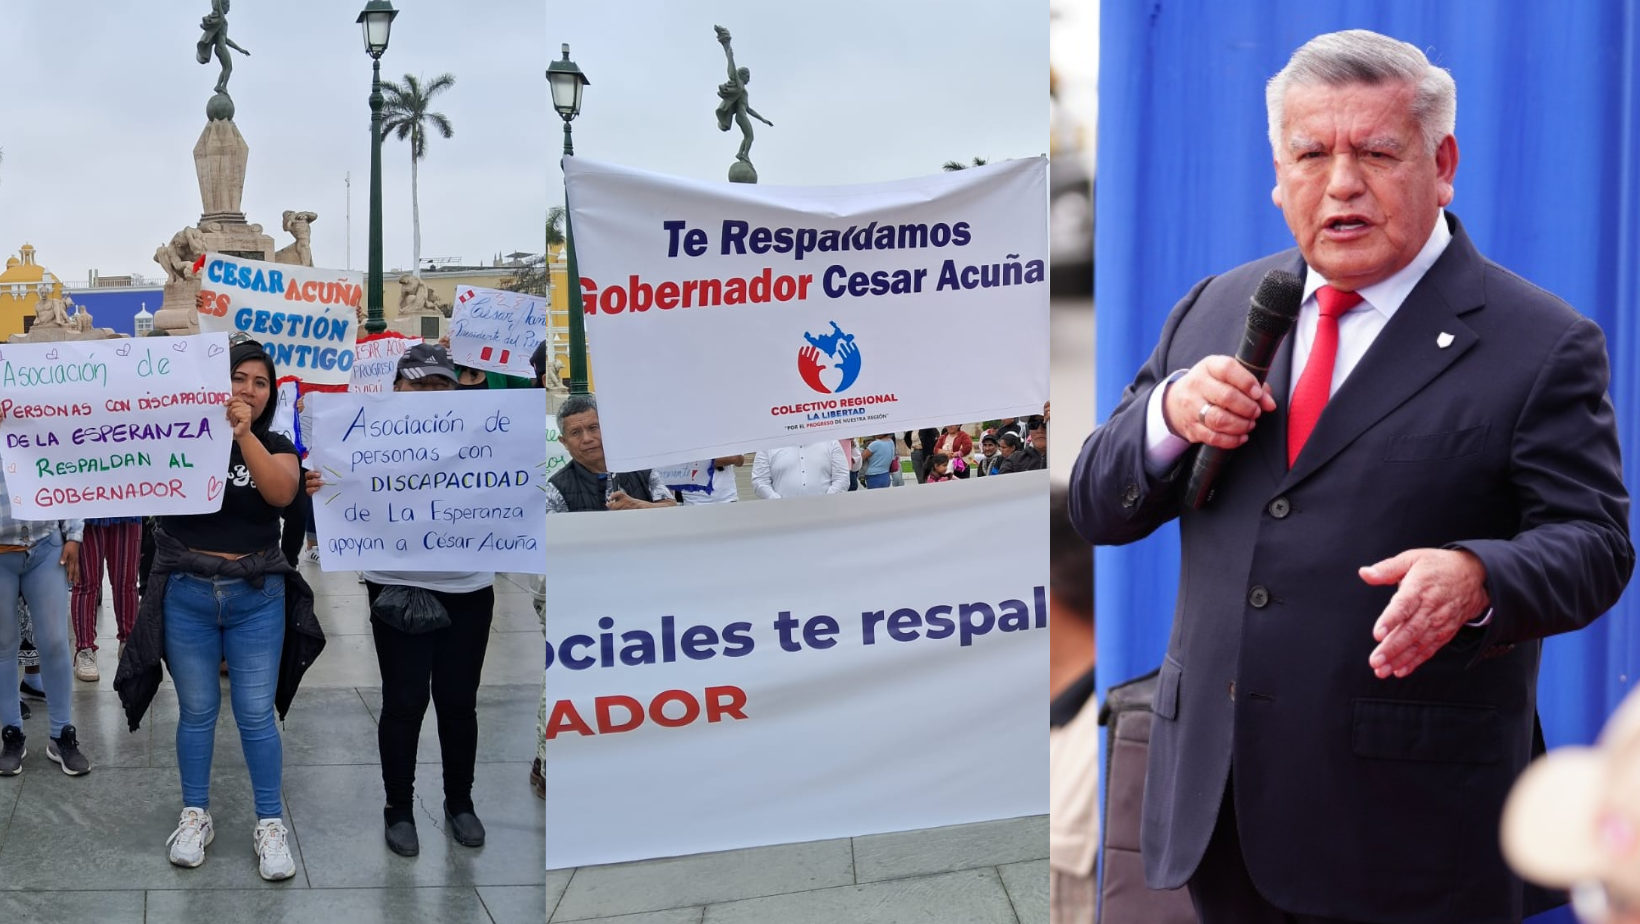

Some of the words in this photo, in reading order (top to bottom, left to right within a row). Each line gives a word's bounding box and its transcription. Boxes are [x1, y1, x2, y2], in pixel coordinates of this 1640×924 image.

[664, 220, 708, 257] Te
[721, 219, 971, 260] Respaldamos
[208, 260, 284, 293] CESAR
[284, 277, 362, 307] ACUÑA
[823, 265, 927, 298] Cesar
[936, 253, 1044, 291] Acuña
[198, 290, 230, 317] ES
[235, 307, 349, 342] GESTIÓN
[354, 341, 381, 361] ESAR
[504, 332, 519, 347] del
[4, 353, 107, 387] Asociación
[137, 348, 170, 378] de
[264, 342, 354, 372] ONTIGO
[1, 399, 92, 419] PERSONAS
[105, 399, 131, 412] CON
[771, 400, 837, 416] COLECTIVO
[840, 394, 898, 407] REGIONAL
[821, 407, 866, 419] LIBERTAD
[7, 434, 30, 448] DE
[36, 432, 59, 446] LA
[72, 417, 213, 445] ESPERANZA
[342, 406, 464, 442] Asociación
[484, 410, 511, 432] de
[806, 420, 834, 428] PROGRESO
[36, 452, 151, 478] RESPALDAN
[169, 453, 194, 468] AL
[351, 446, 440, 472] personas
[458, 445, 493, 460] con
[35, 479, 186, 507] GOBERNADOR
[371, 471, 529, 493] DISCAPACIDAD
[344, 503, 371, 522] de
[389, 503, 414, 522] La
[431, 500, 524, 525] Esperanza
[328, 537, 384, 556] apoyan
[396, 540, 407, 551] a
[423, 531, 475, 550] César
[477, 532, 537, 552] Acuña
[546, 615, 755, 671] ciales
[774, 611, 840, 652] te
[861, 586, 1047, 647] respal
[546, 685, 749, 740] ADOR
